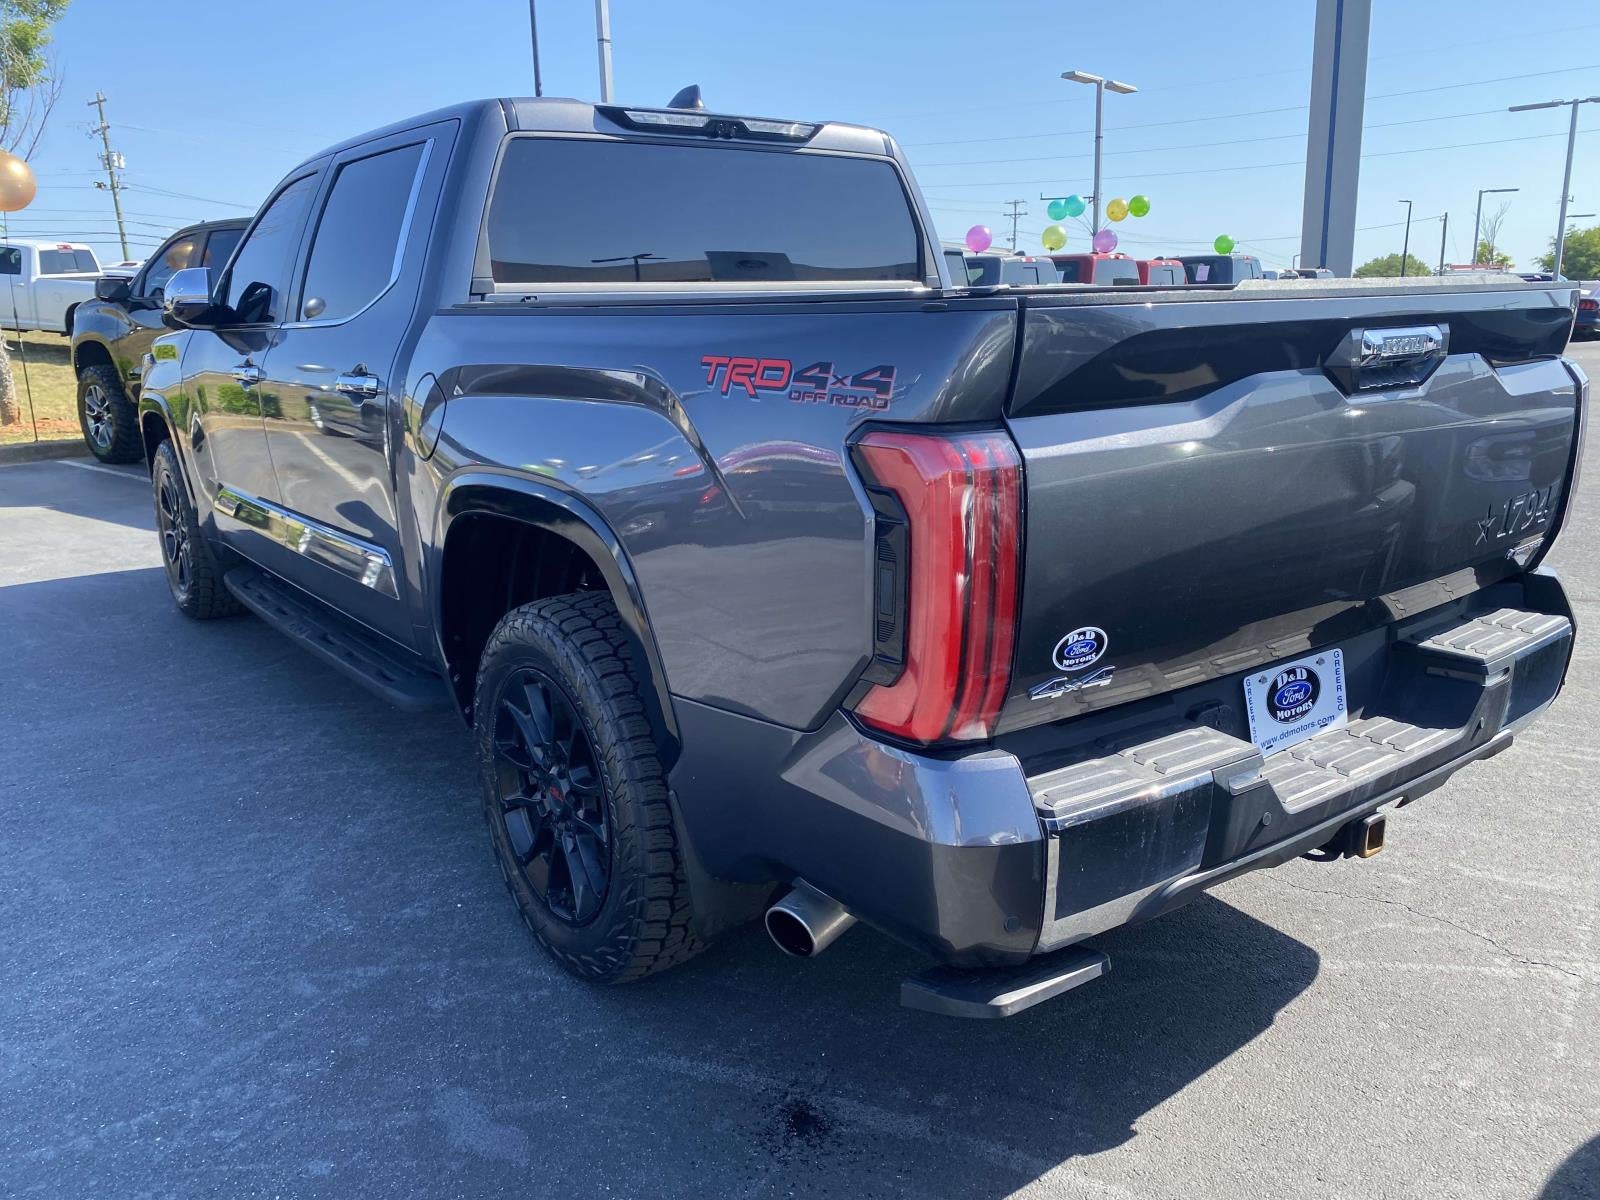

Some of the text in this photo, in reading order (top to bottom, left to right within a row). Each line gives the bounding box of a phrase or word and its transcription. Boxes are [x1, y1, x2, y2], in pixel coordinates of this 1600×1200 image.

[701, 355, 793, 400] TRD
[788, 390, 890, 411] OFF ROAD
[1496, 486, 1552, 538] 1794
[1067, 630, 1096, 646] D&D
[1070, 642, 1091, 656] Ford
[1062, 652, 1097, 667] MOTORS
[1276, 668, 1308, 690] D&D
[1333, 650, 1344, 712] GREER SC
[1282, 685, 1306, 705] Ford
[1276, 699, 1313, 721] MOTORS
[1260, 714, 1335, 749] www.ddmotors.com
